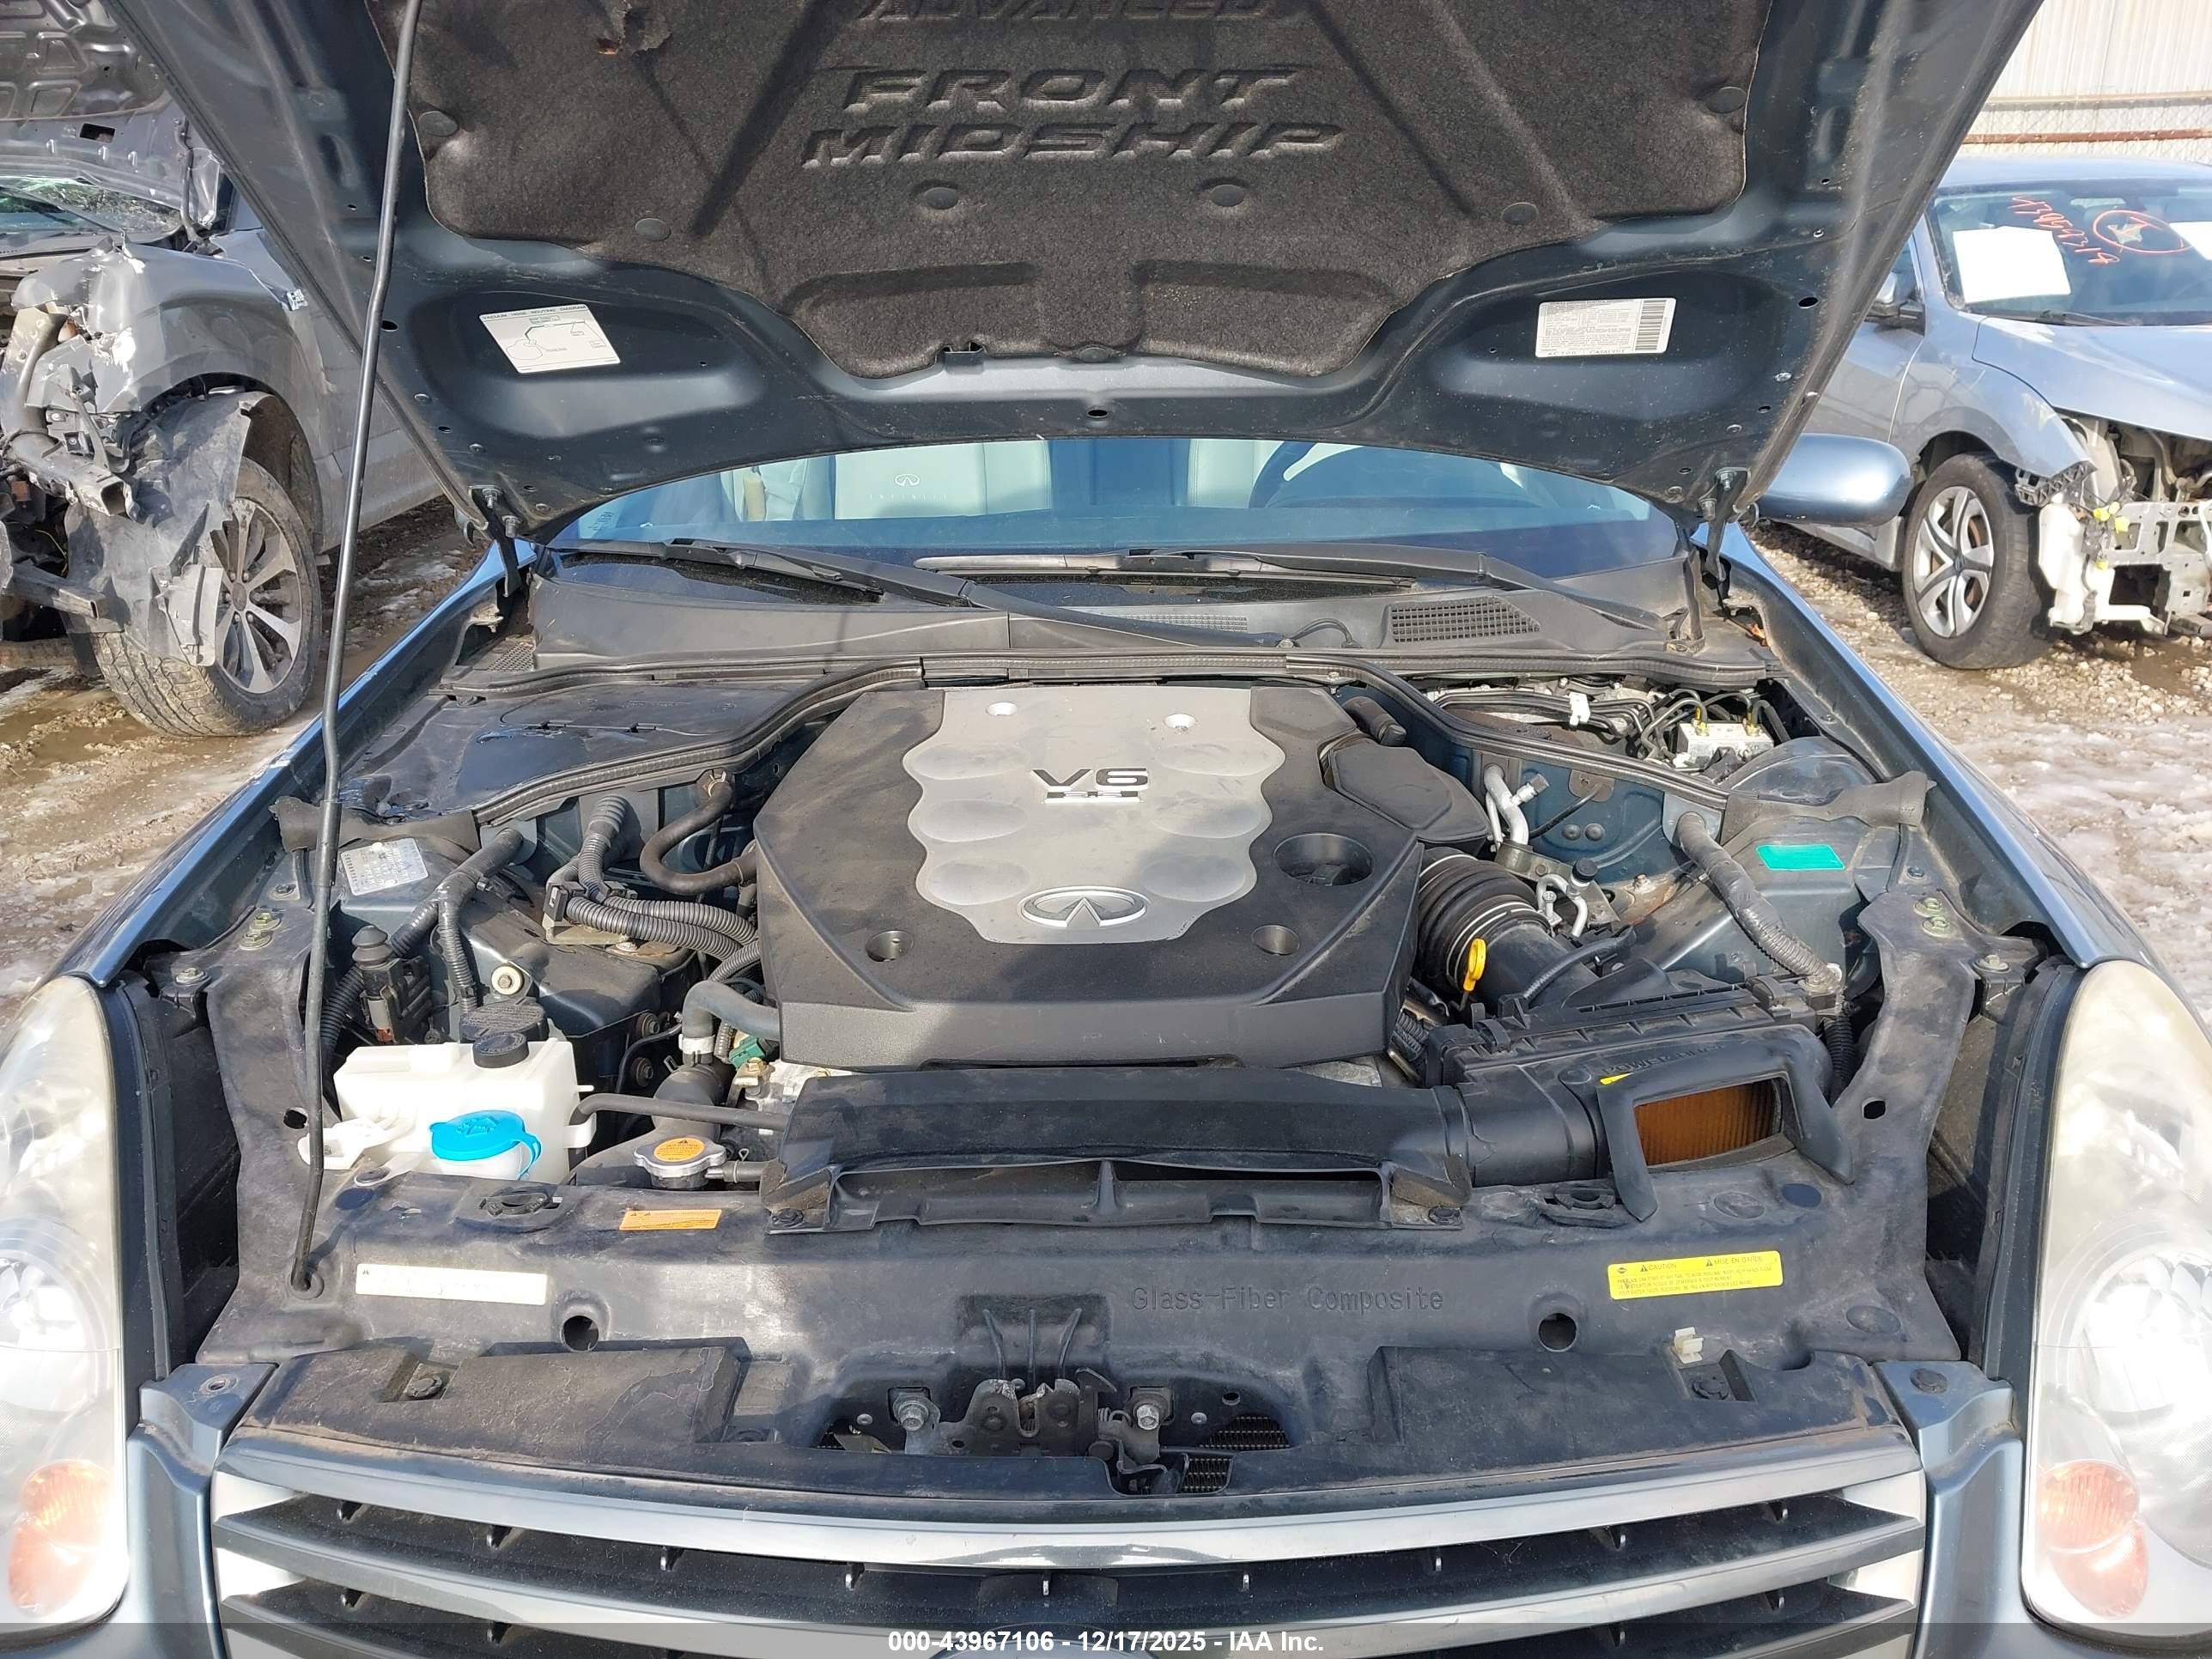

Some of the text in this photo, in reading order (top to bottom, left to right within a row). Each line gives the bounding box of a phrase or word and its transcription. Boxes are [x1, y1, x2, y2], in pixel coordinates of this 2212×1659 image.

[842, 67, 1300, 112] FRONT
[799, 122, 1346, 170] MIDSHIP
[1030, 767, 1149, 791] V6
[1602, 1054, 1671, 1075] POWER
[1648, 1262, 1677, 1271] CAUTION
[1131, 1285, 1444, 1316] Glass-Fiber Composite
